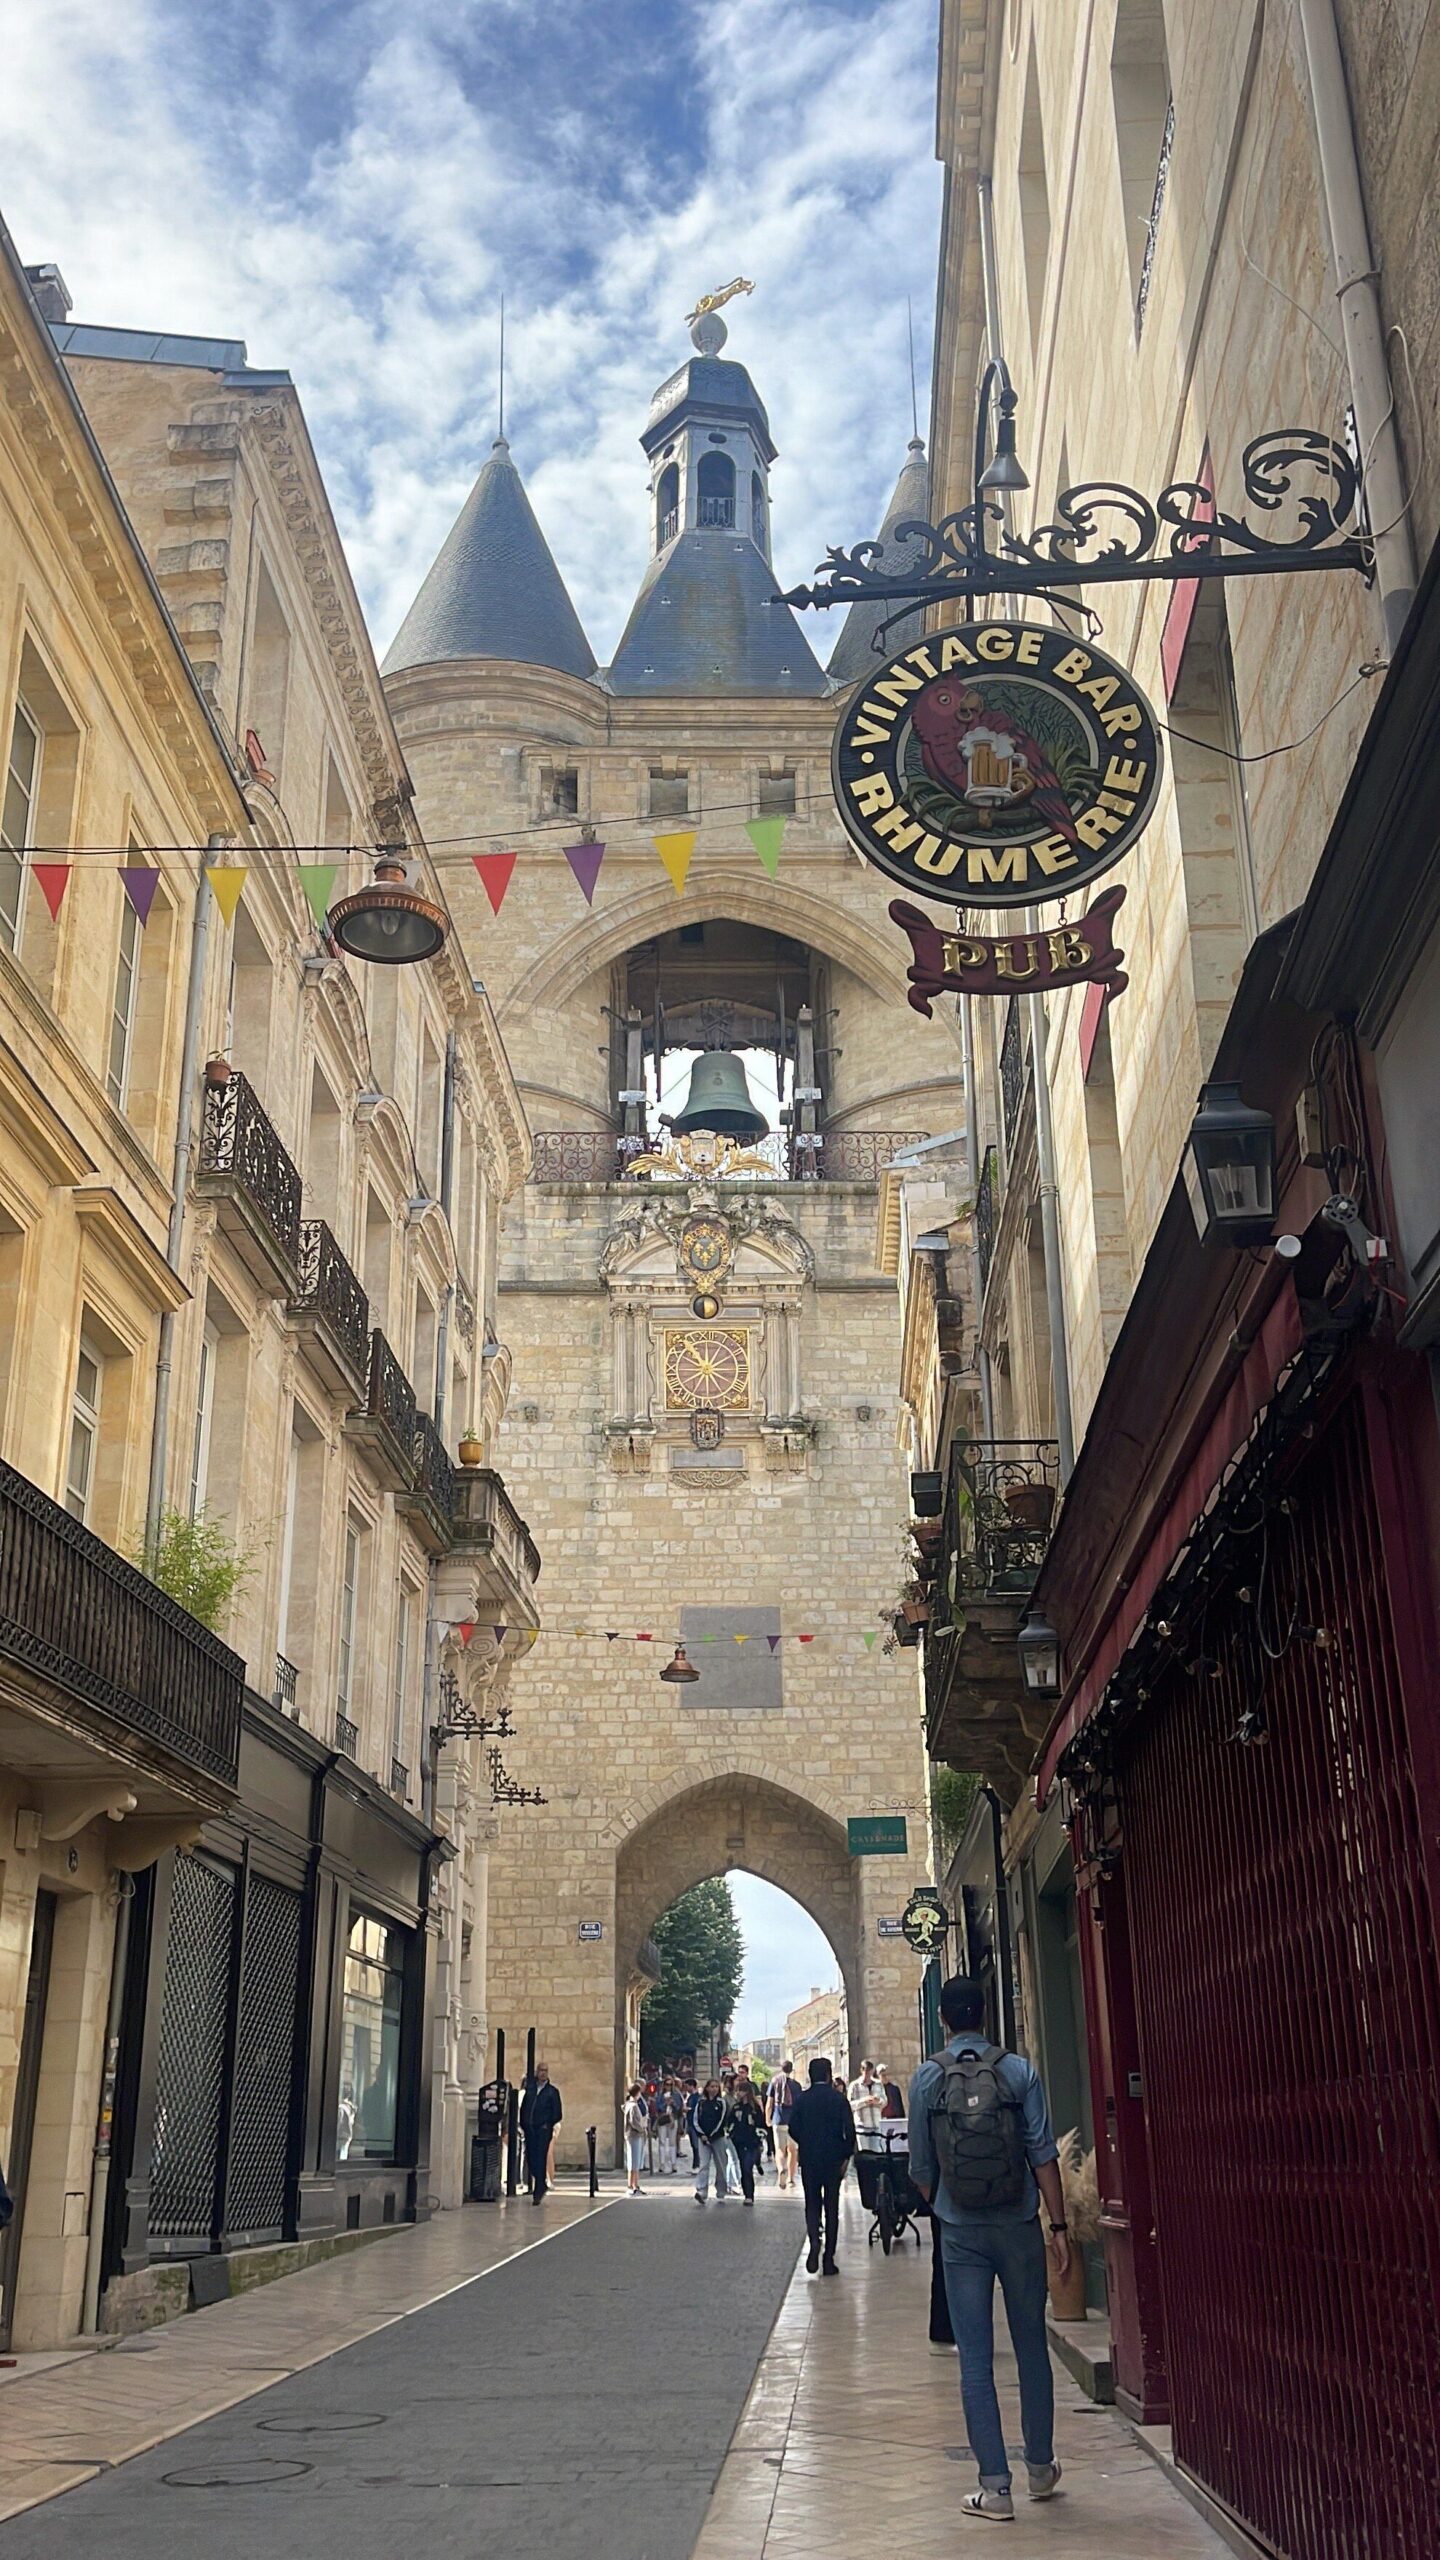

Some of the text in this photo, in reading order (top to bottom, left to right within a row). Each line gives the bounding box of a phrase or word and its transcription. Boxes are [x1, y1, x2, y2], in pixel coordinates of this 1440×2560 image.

[850, 627, 1143, 748] VINTAGE BAR
[849, 754, 1148, 884] RHUMERIE
[941, 927, 1094, 981] PUB
